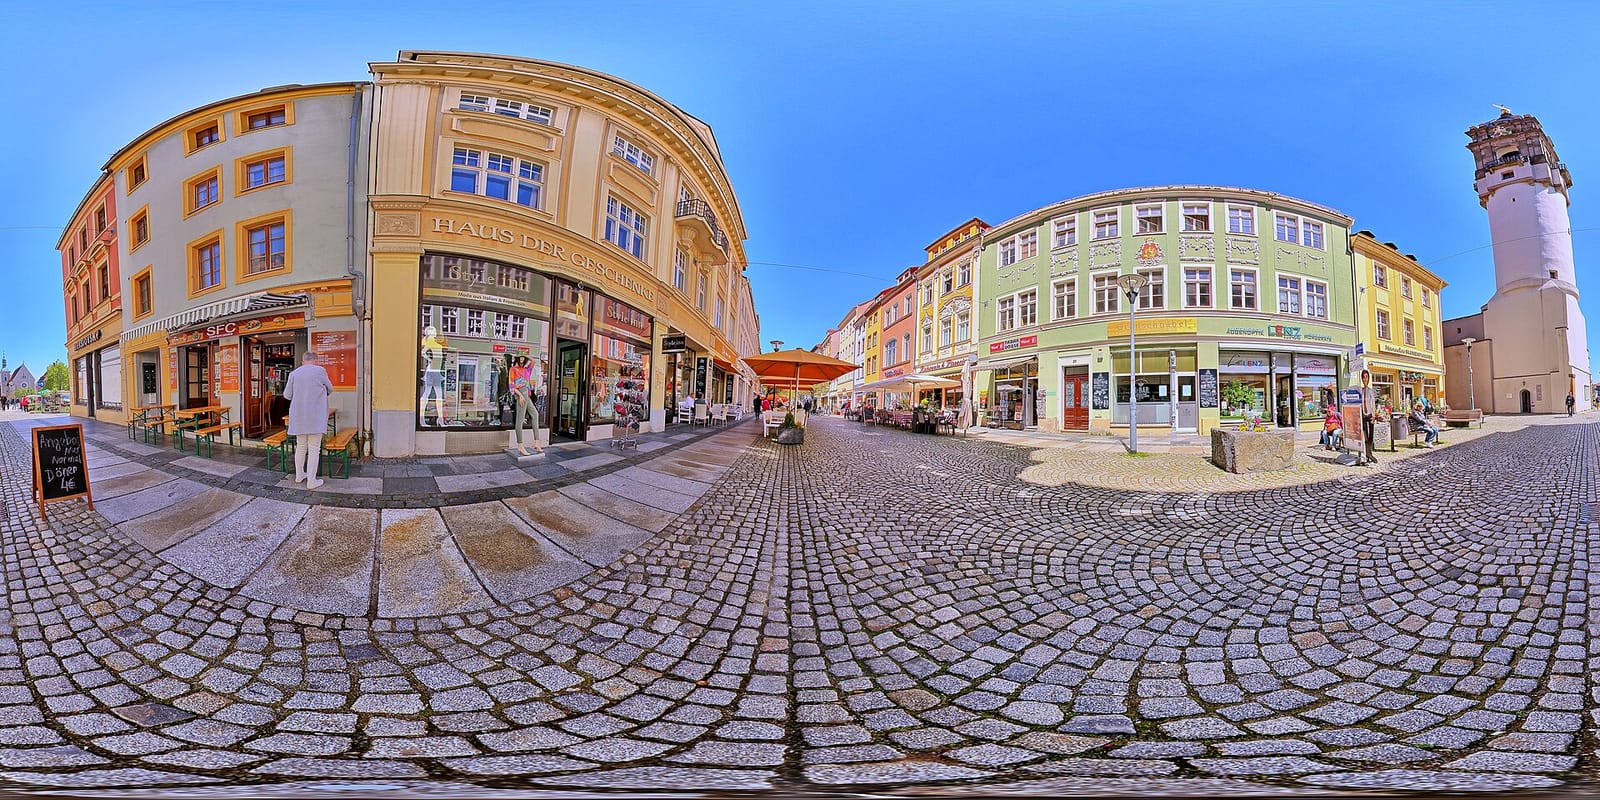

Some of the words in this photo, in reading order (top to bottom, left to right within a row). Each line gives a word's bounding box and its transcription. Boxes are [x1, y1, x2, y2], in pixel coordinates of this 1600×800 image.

[432, 217, 514, 244] HAUS
[520, 234, 567, 261] DER
[570, 252, 655, 302] GESCHENKE
[449, 265, 495, 287] Style
[606, 305, 628, 324] Style
[206, 323, 236, 337] SFC
[470, 320, 487, 329] Jede
[1117, 319, 1187, 332] grnschnabel
[1226, 327, 1264, 336] AUGENOPTIK
[1268, 325, 1301, 338] LENZ
[44, 466, 78, 483] Döner
[61, 476, 77, 492] 4€
